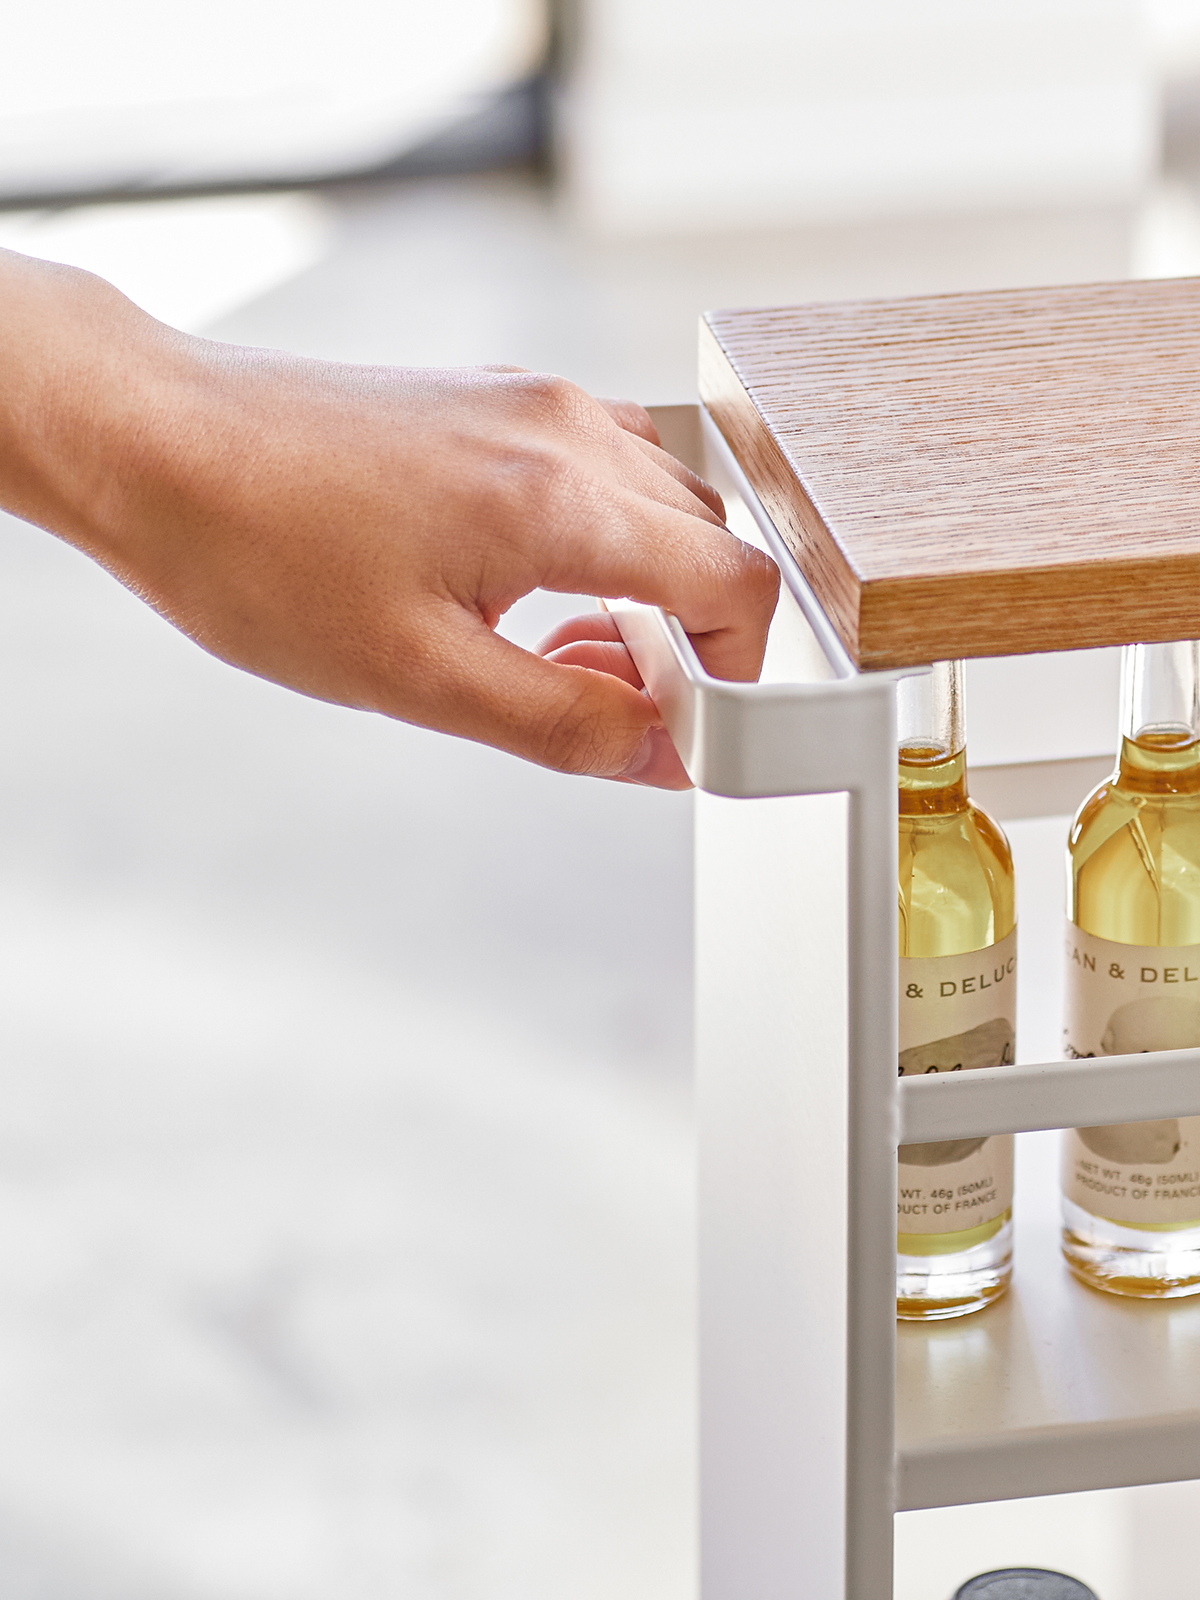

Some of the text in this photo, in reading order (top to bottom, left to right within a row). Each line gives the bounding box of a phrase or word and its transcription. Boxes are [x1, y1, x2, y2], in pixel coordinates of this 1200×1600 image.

[1108, 963, 1126, 980] &
[905, 983, 924, 999] &
[930, 1188, 954, 1201] 46g
[1131, 1188, 1150, 1200] OF
[933, 1203, 951, 1216] OF
[954, 1189, 998, 1213] FRANCE
